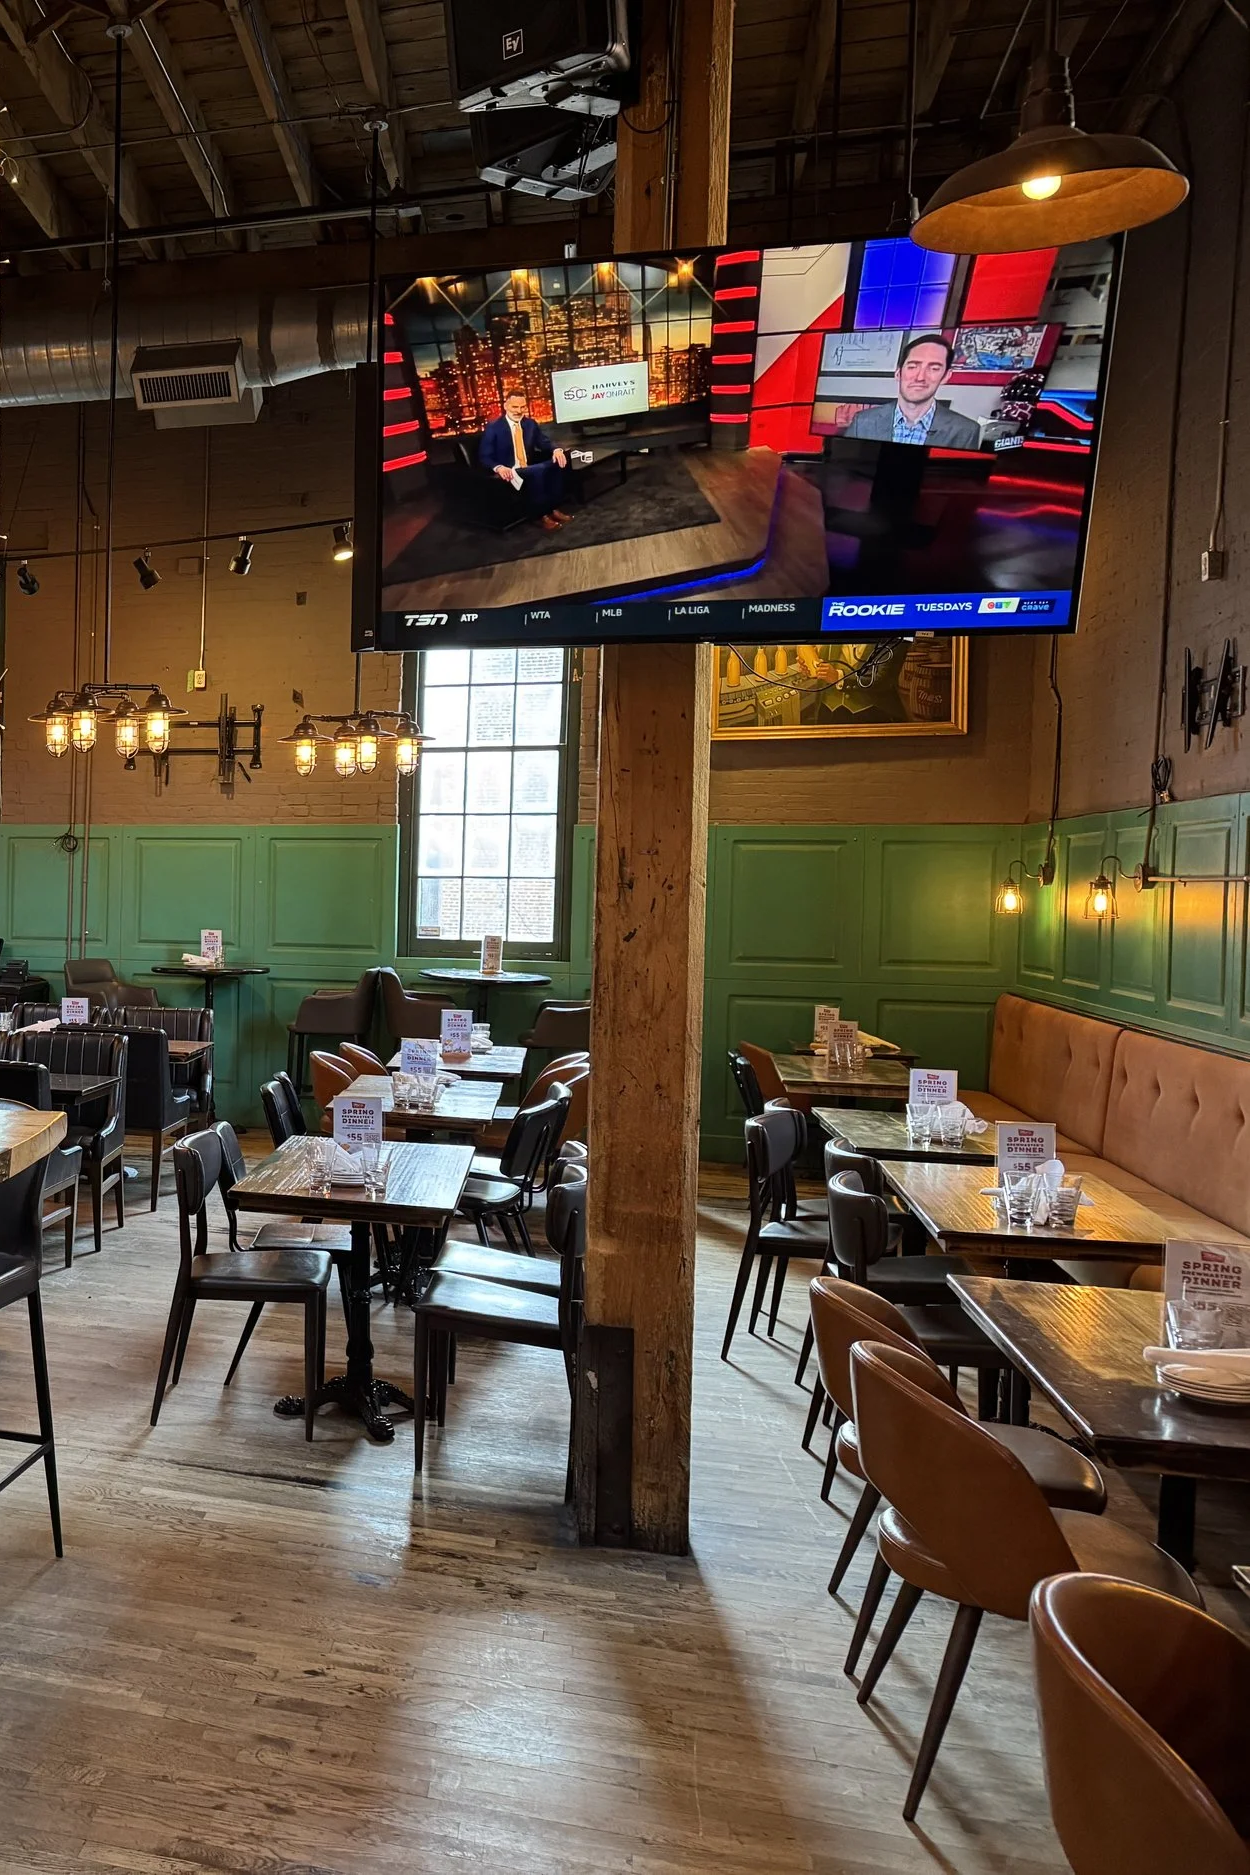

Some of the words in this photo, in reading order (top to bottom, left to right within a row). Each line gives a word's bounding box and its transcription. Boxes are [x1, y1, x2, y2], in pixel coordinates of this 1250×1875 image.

[506, 36, 520, 52] EV
[994, 435, 1025, 449] GIANTS
[404, 613, 448, 626] TSN
[460, 613, 479, 623] ATP
[530, 611, 551, 620] WTA
[601, 608, 623, 617] MLB
[674, 606, 687, 615] LA
[688, 605, 710, 615] LIGA
[748, 603, 796, 613] MADNESS
[828, 603, 906, 617] ROOKIE
[915, 602, 973, 612] TUESDAYS
[341, 1108, 375, 1116] SPRING
[346, 1132, 363, 1141] $55
[1007, 1136, 1045, 1144] SPRING
[1007, 1146, 1045, 1154] DINNER
[1013, 1162, 1031, 1171] $55
[1182, 1261, 1242, 1275] SPRING
[1182, 1275, 1242, 1290] DINNER
